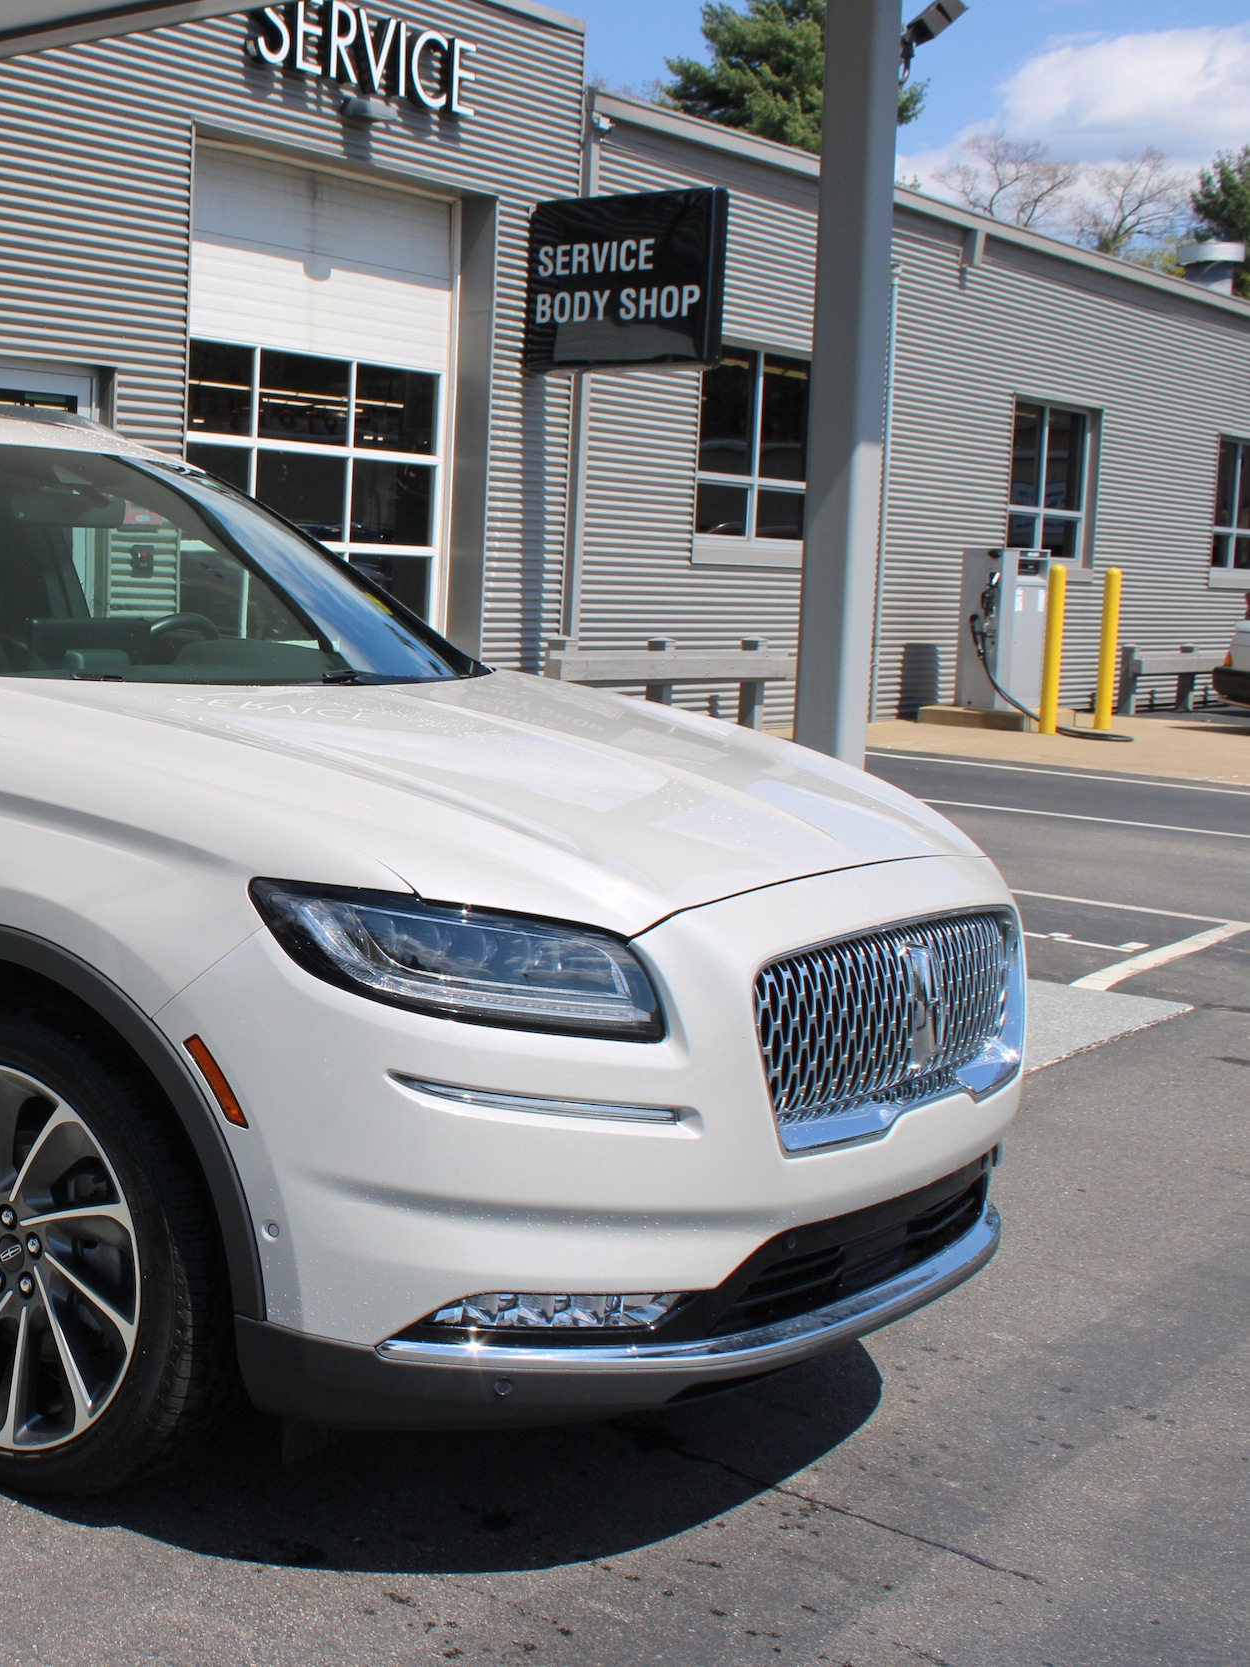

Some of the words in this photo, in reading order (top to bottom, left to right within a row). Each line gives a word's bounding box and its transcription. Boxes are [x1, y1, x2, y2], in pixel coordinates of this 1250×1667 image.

[256, 0, 478, 117] SERVICE
[537, 237, 656, 278] SERVICE
[535, 288, 612, 324] BODY
[618, 283, 701, 320] SHOP
